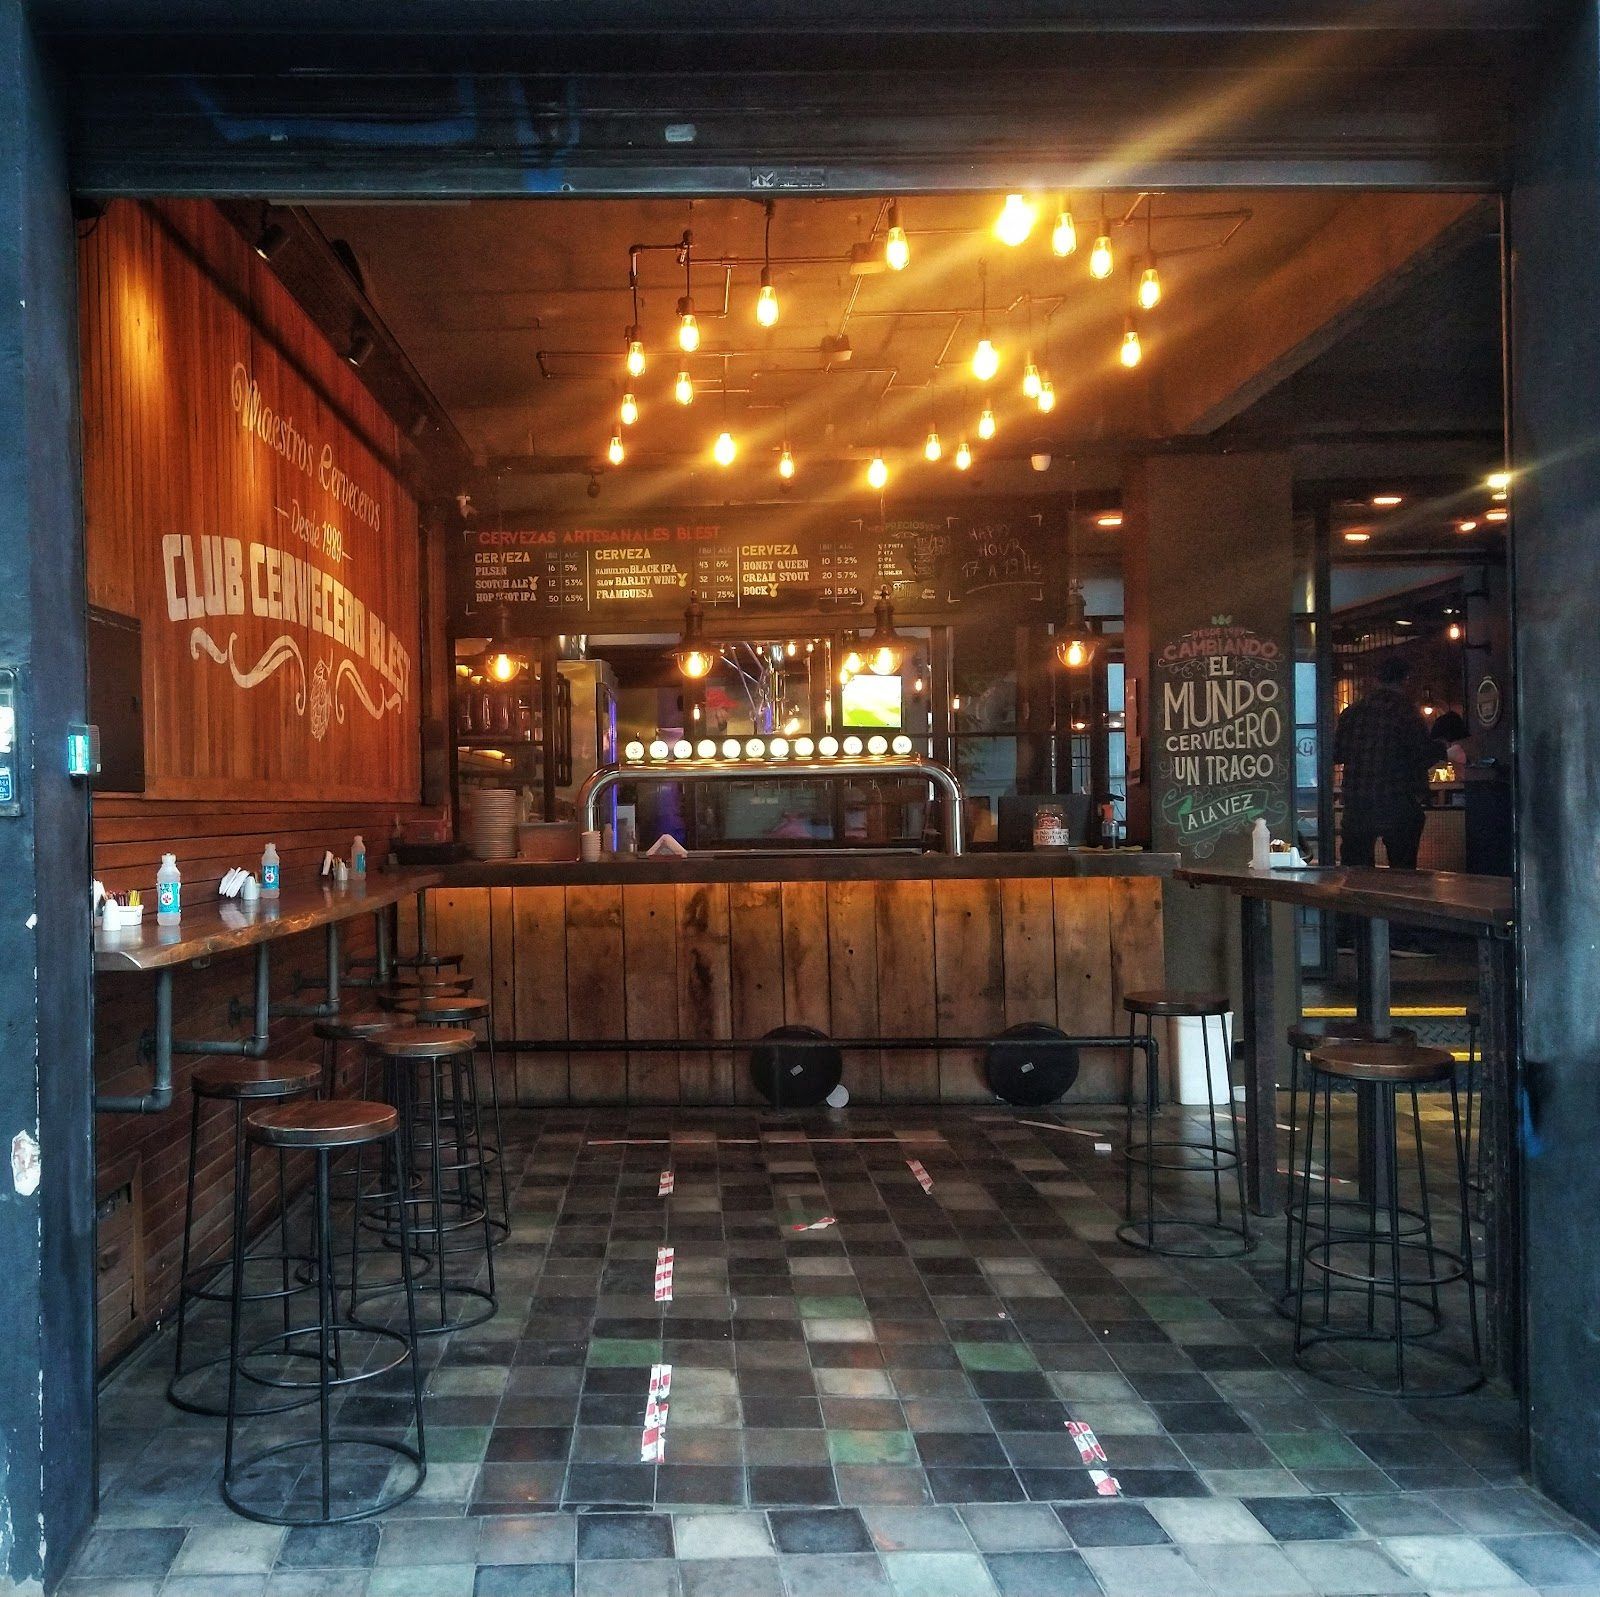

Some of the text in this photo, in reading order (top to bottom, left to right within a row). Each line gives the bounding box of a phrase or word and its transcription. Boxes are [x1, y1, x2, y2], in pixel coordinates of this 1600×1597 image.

[231, 362, 381, 532] Maestros Cerveceros
[291, 498, 342, 563] Desde 1989
[479, 525, 721, 545] CERVEZAS ARTESANALES BLEST
[594, 548, 651, 561] CERVEZA
[741, 544, 799, 556] CERVEZA
[474, 551, 531, 564] CERVEZA
[743, 560, 774, 570] HONEY
[777, 559, 809, 569] QUEEN
[821, 557, 831, 565] 10
[475, 563, 578, 576] PILSEN 16 5%
[629, 564, 660, 574] BLACK
[661, 563, 678, 573] IPA
[961, 561, 979, 578] 17
[475, 579, 510, 588] SCOTCH
[511, 578, 529, 588] ALE
[548, 579, 557, 587] 12
[596, 575, 734, 587] SLOW BARLEY WINE 32 10%
[742, 571, 777, 583] CREAM
[779, 571, 810, 582] STOUT
[822, 571, 833, 579] 20
[476, 592, 495, 602] HOP
[520, 591, 537, 602] IPA
[548, 595, 560, 603] 50
[596, 588, 654, 600] FRAMBUESA
[743, 585, 769, 596] BOCK
[824, 587, 833, 595] 16
[162, 534, 411, 702] CLUB CERVECERO BLEST
[1164, 637, 1279, 661] CAMBIANDO
[1209, 655, 1234, 676] EL
[1164, 679, 1279, 731] MUNDO
[1166, 706, 1281, 752] CERVECERO
[1174, 753, 1274, 786] UN TRAGO
[1187, 793, 1254, 830] A LA VEZ
